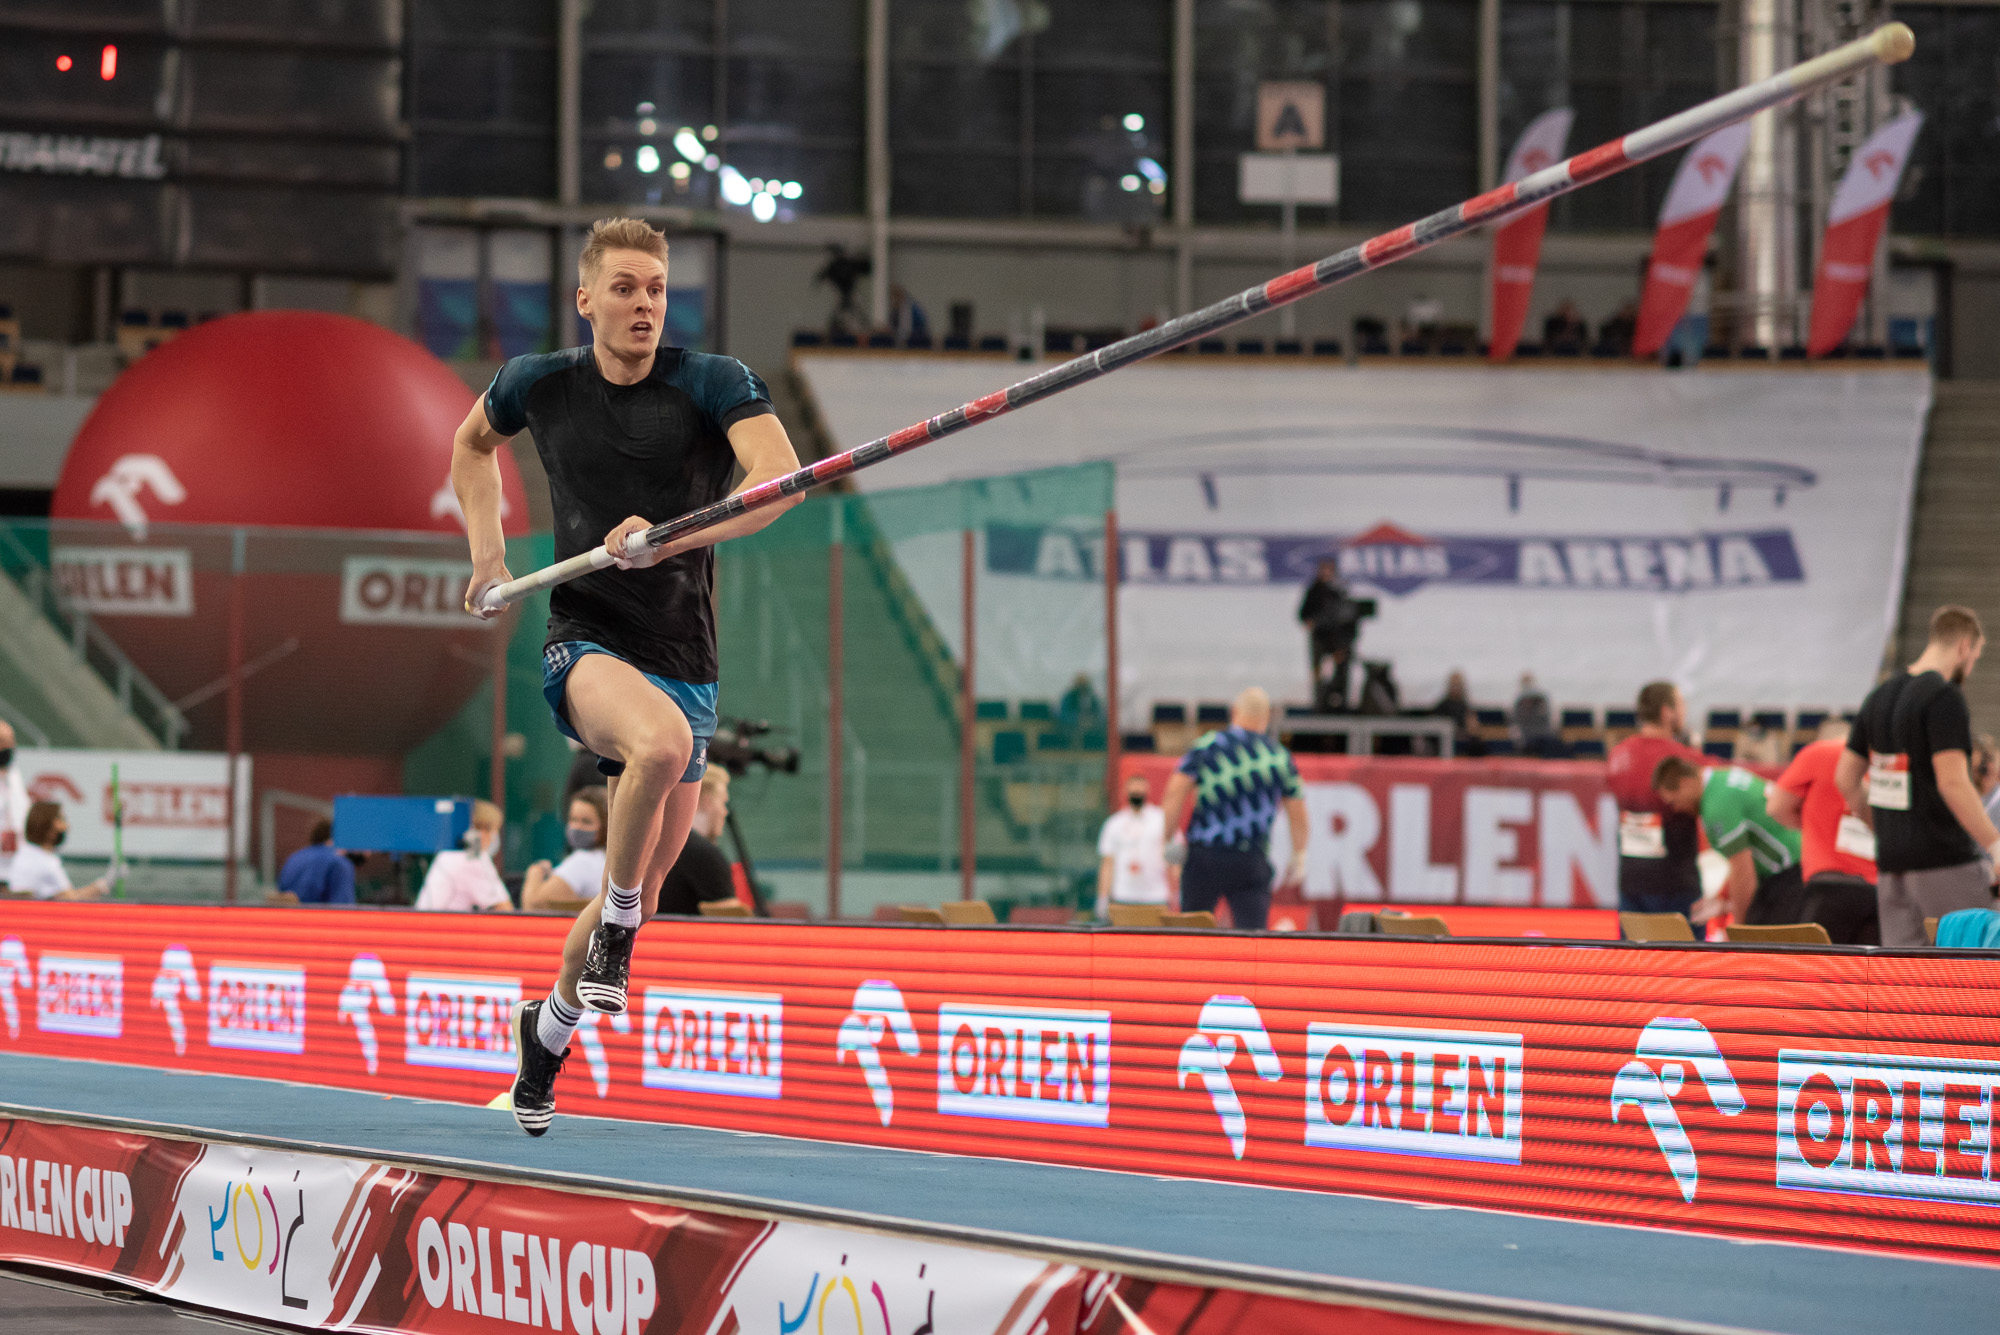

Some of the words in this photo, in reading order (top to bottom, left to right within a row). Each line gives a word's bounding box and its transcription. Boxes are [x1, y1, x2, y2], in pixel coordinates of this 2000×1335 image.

[1518, 539, 1772, 586] ARENA
[1269, 781, 1618, 907] RLEN
[654, 1006, 770, 1077] ORLEN
[951, 1023, 1097, 1103] ORLEN
[1320, 1044, 1507, 1138] ORLEN
[1793, 1072, 2000, 1183] ORLE
[75, 1165, 132, 1248] CUP
[417, 1216, 562, 1331] ORLEN
[567, 1241, 656, 1335] CUP
